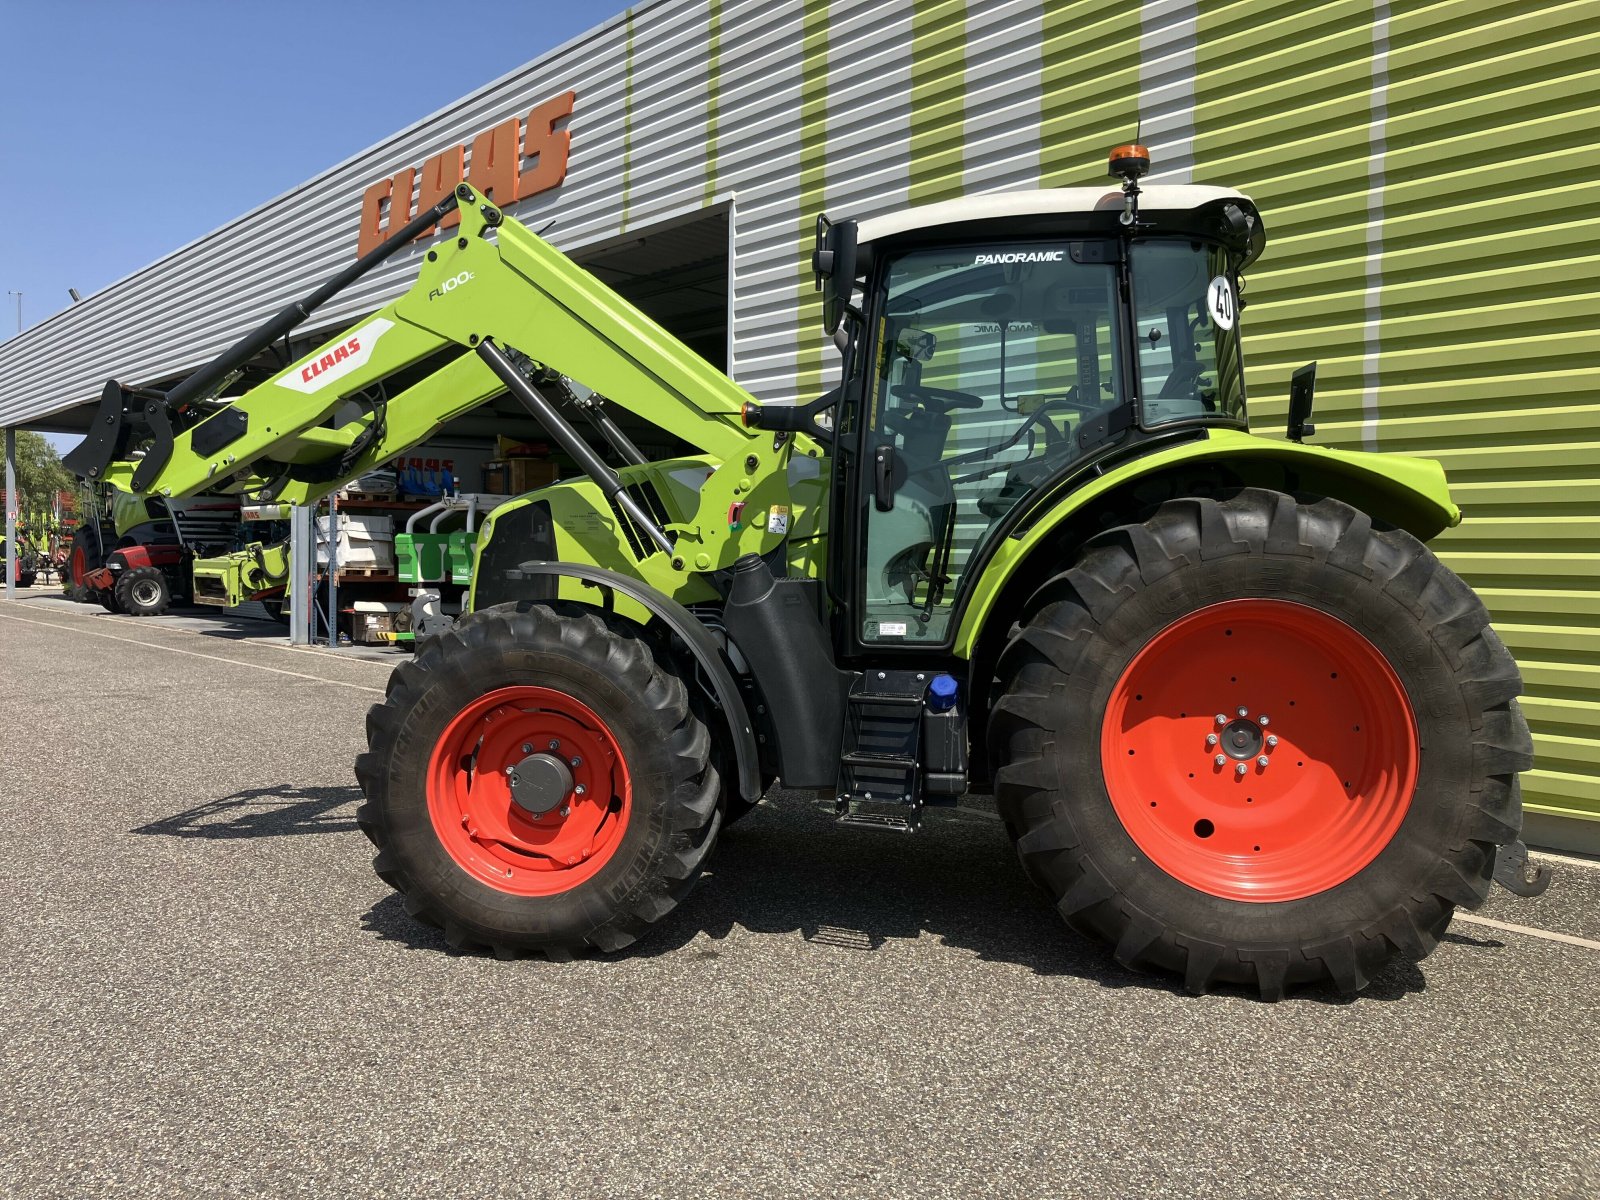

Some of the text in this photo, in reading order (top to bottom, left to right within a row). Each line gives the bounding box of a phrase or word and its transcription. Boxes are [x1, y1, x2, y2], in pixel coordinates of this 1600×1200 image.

[357, 91, 575, 261] CLAAS
[975, 251, 1063, 264] PANORAMIC
[1216, 285, 1231, 320] 40
[301, 337, 361, 383] CLAAS
[390, 683, 444, 783] MICHELIN
[608, 812, 662, 902] MICHELIN
